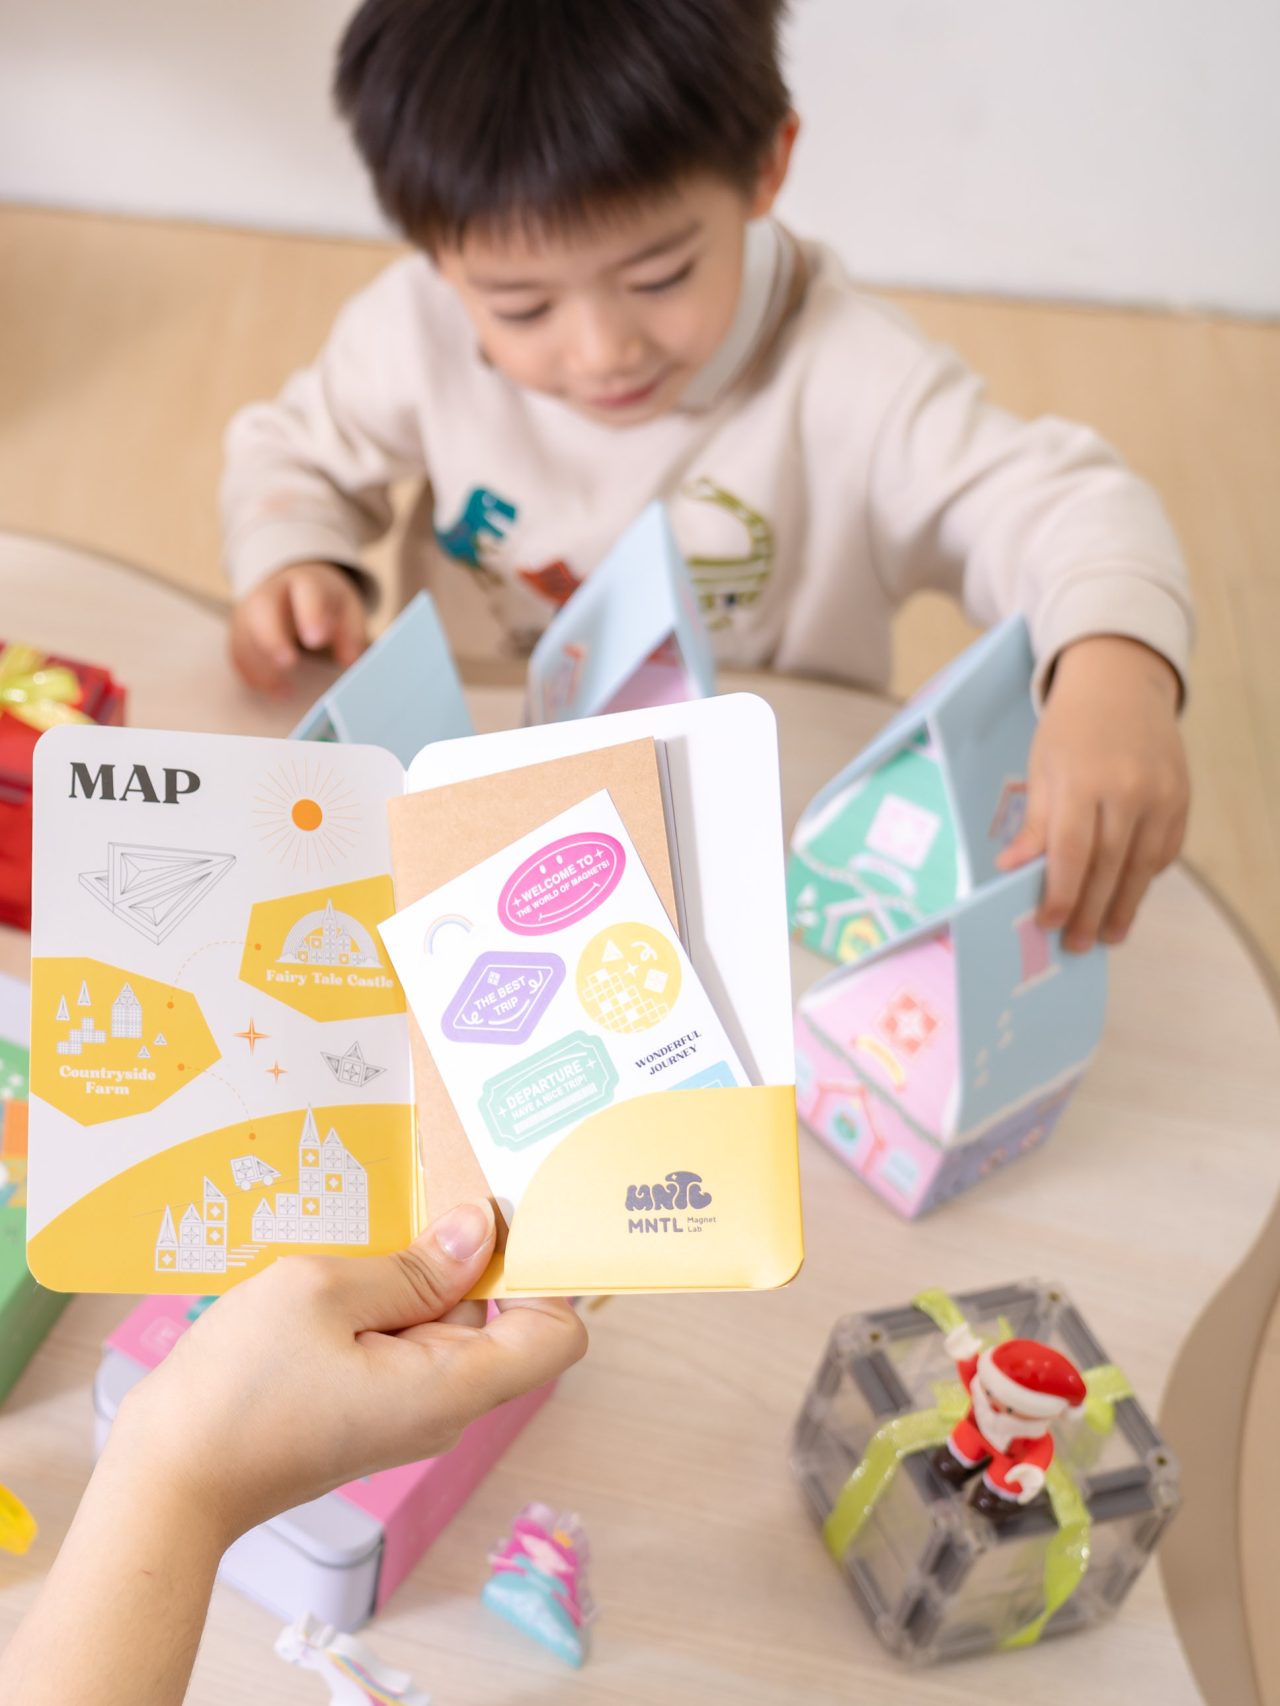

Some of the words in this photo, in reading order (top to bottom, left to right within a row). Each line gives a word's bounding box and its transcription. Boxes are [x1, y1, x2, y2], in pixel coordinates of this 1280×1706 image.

[68, 761, 201, 805] MAP
[516, 904, 532, 918] THE
[532, 889, 559, 909] WORLD
[560, 882, 571, 894] OF
[570, 859, 611, 887] MAGNETS!
[521, 864, 577, 903] WELCOME
[576, 854, 594, 869] TO
[266, 969, 307, 986] Fairy
[312, 971, 343, 985] Tale
[347, 974, 394, 988] Castle
[474, 992, 497, 1010] THE
[497, 976, 526, 999] BEST
[493, 996, 519, 1016] TRIP
[635, 1030, 702, 1069] WONDERFUL
[649, 1044, 697, 1075] JOURNEY
[59, 1065, 156, 1082] Countryside
[85, 1081, 130, 1096] Farm
[505, 1059, 584, 1110] DEPARTURE
[511, 1101, 536, 1121] HAVE
[535, 1098, 544, 1107] A
[542, 1087, 565, 1105] NICE
[564, 1074, 588, 1093] TRIP!
[628, 1216, 684, 1233] MNTL
[687, 1217, 717, 1225] Magnet
